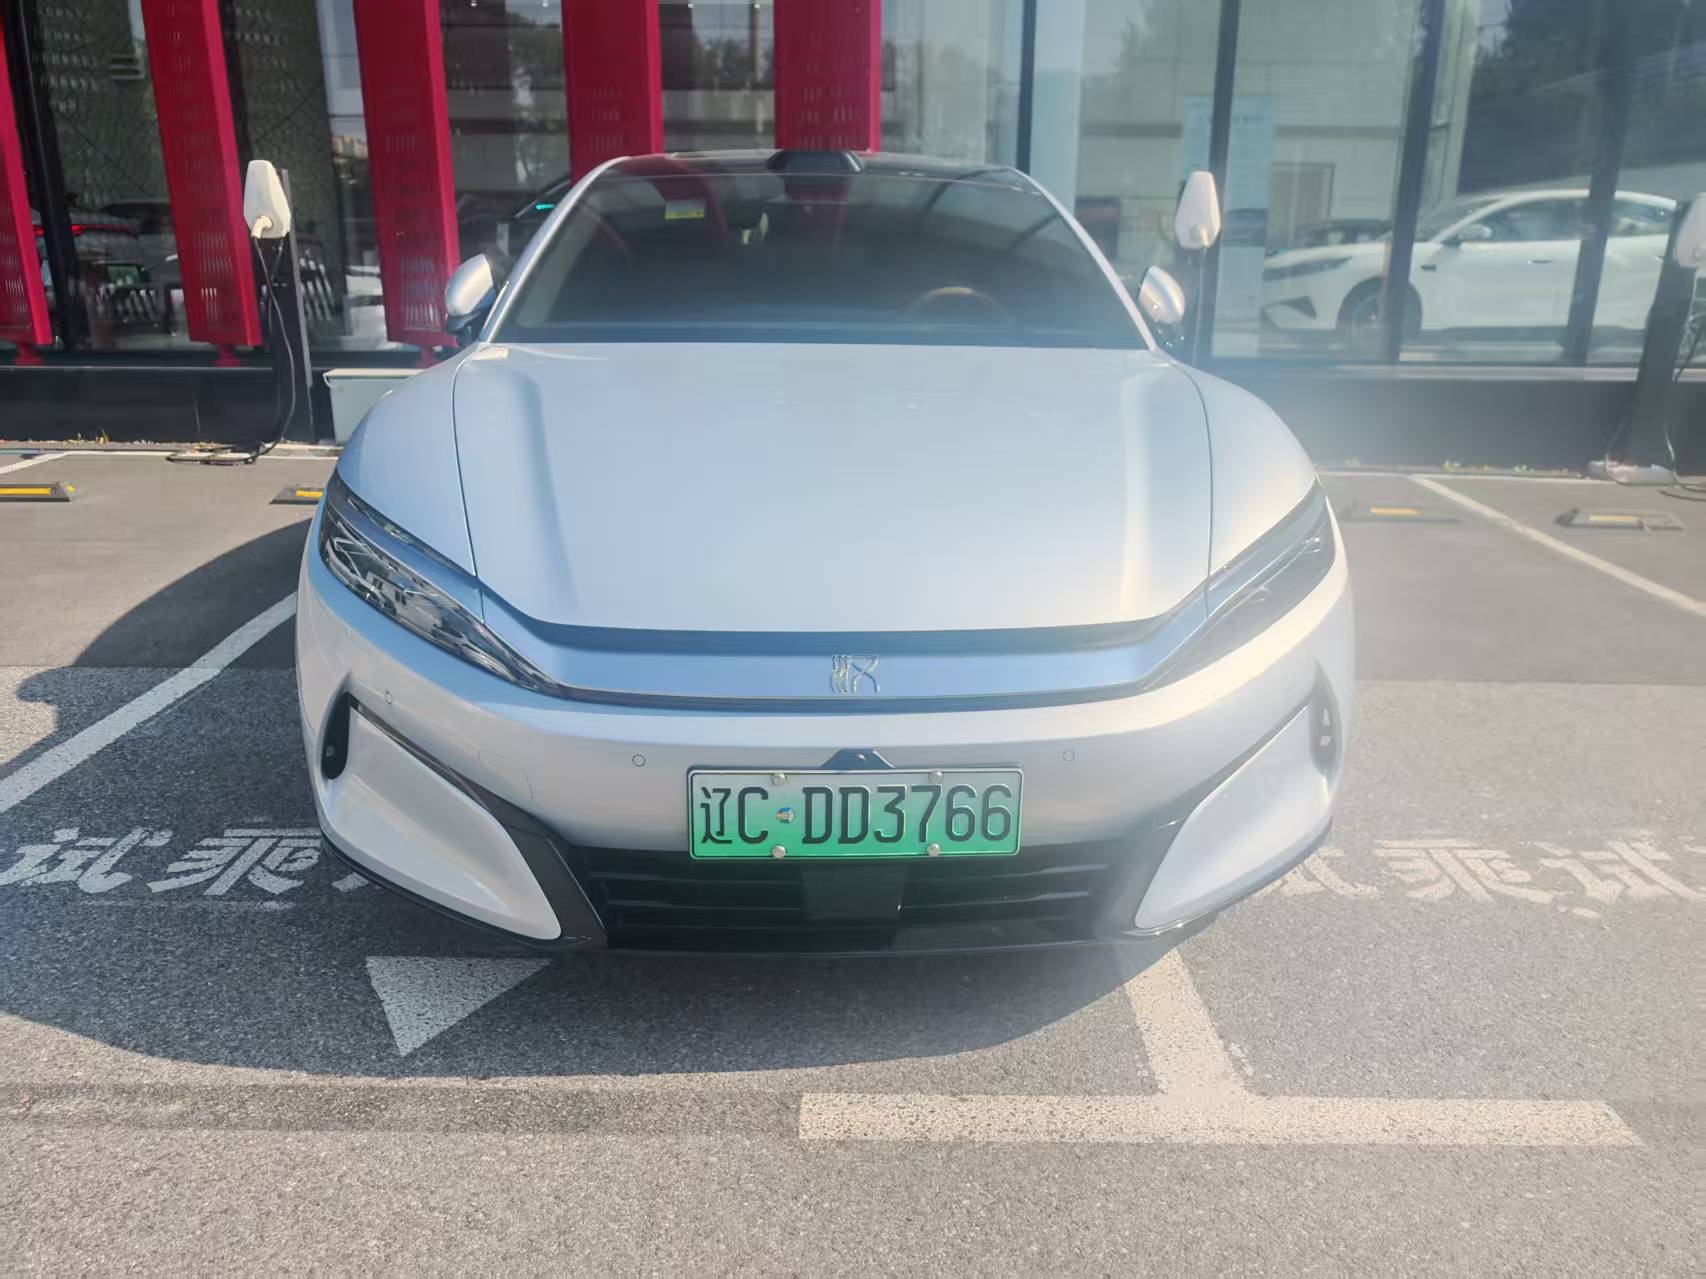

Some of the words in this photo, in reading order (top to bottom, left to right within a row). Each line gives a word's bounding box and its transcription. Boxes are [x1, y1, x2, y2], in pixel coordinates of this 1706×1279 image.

[701, 786, 769, 845] 辽C
[802, 784, 1012, 845] DD3766
[0, 827, 371, 895] 试乘
